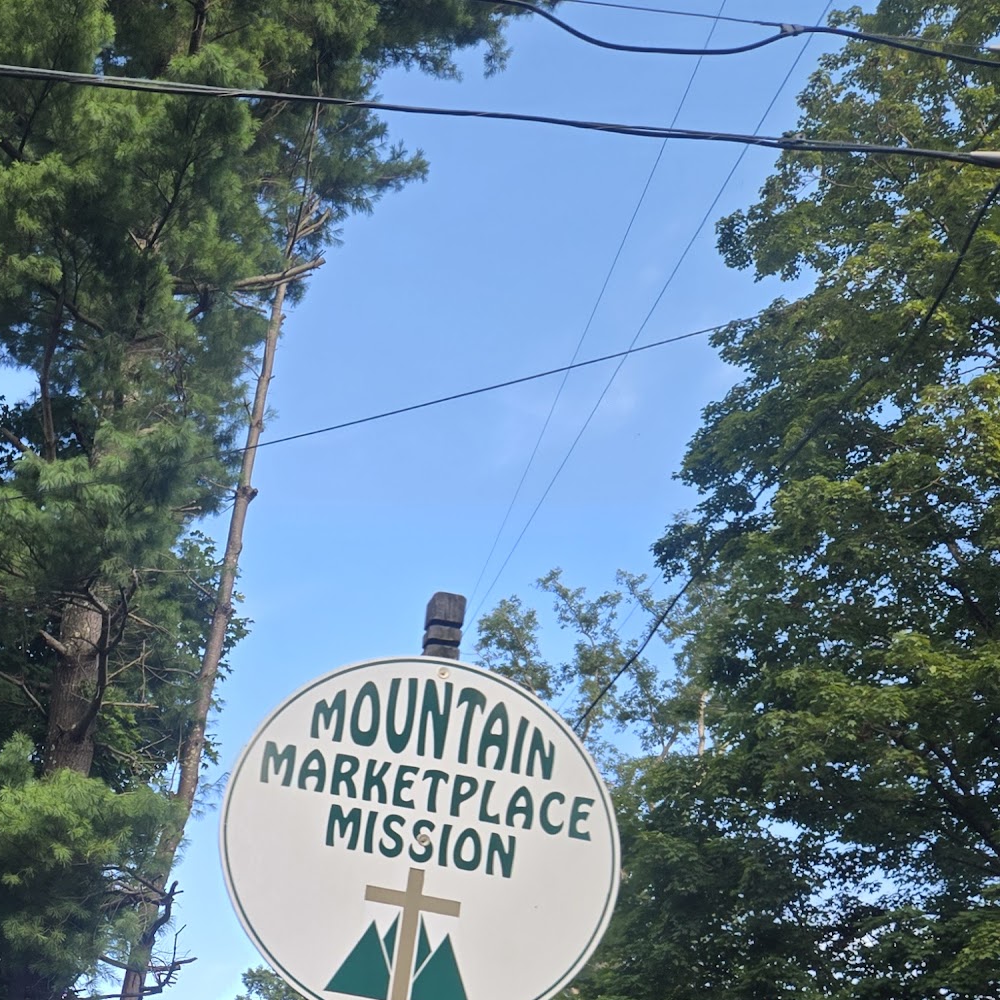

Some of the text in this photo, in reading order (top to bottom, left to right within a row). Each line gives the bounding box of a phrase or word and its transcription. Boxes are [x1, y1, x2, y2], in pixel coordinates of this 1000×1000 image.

[311, 677, 555, 781] MOUNTAIN
[260, 740, 595, 841] MARKETPLACE
[325, 804, 517, 878] MISSION
